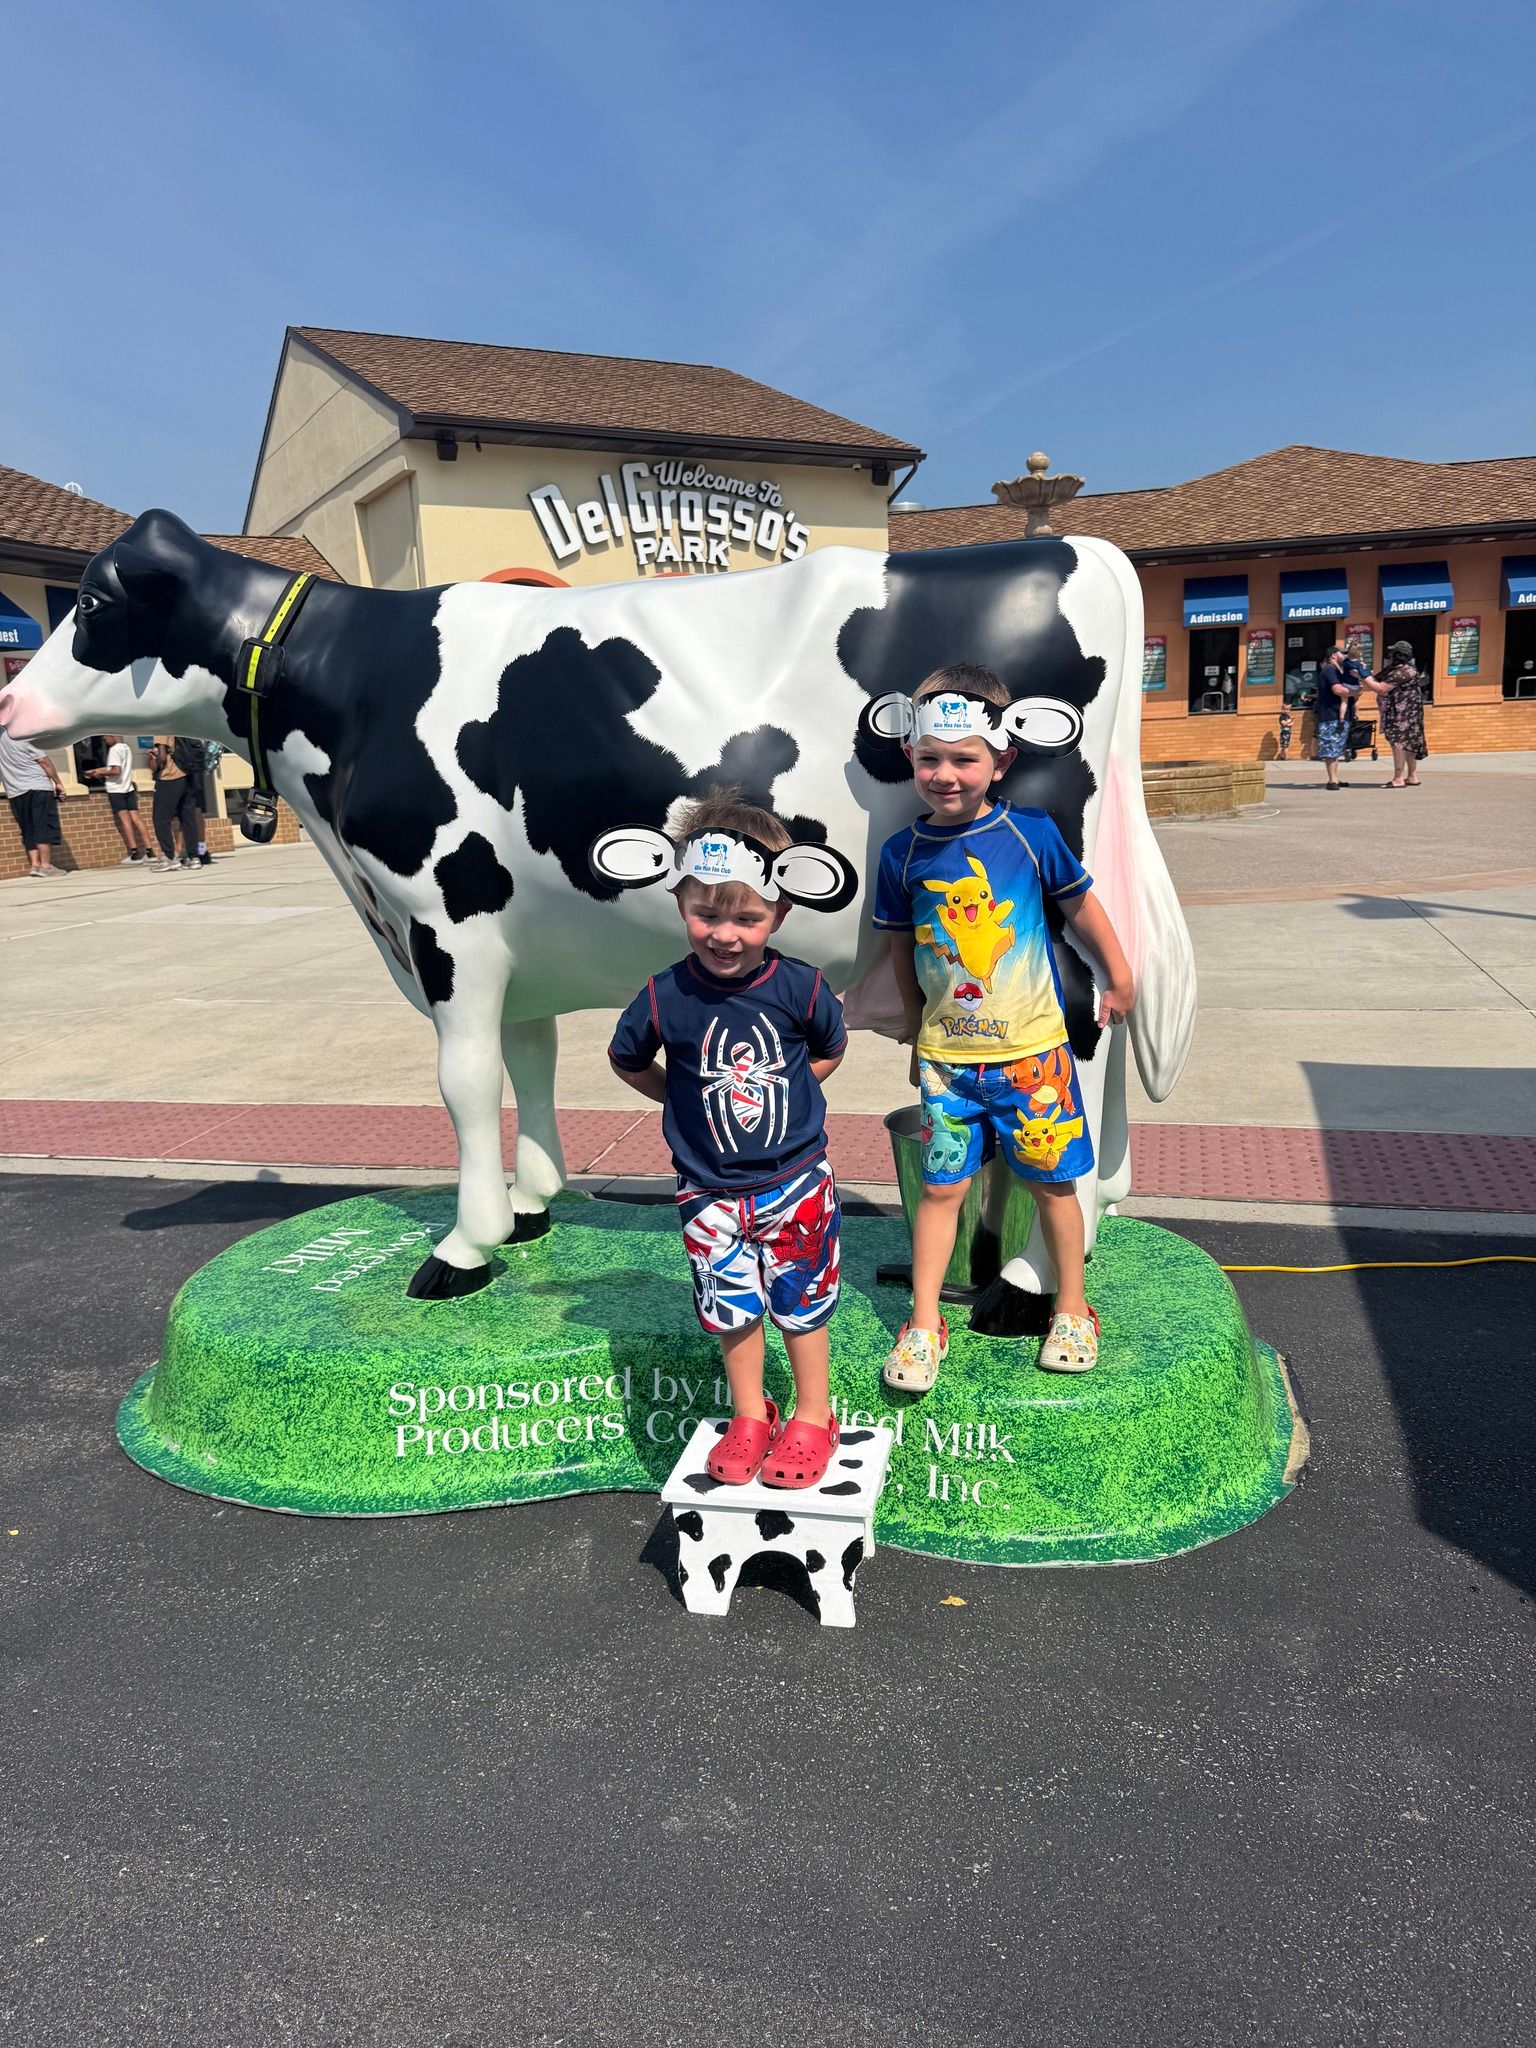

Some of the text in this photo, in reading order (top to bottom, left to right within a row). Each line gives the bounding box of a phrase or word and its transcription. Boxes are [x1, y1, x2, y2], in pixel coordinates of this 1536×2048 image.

[653, 460, 784, 508] Welcome To
[635, 536, 732, 567] PARK
[1390, 600, 1447, 612] Admission
[1518, 593, 1536, 604] Ad
[1189, 612, 1244, 624] Admission
[1288, 605, 1344, 618] Admission
[262, 1226, 373, 1274] Milk!
[343, 1246, 377, 1261] by
[388, 1366, 632, 1422] Sponsored
[653, 1367, 704, 1411] by
[830, 1395, 905, 1447] lied
[923, 1417, 1017, 1463] Milk
[396, 1404, 632, 1457] Producers'
[927, 1464, 1011, 1511] Inc.
